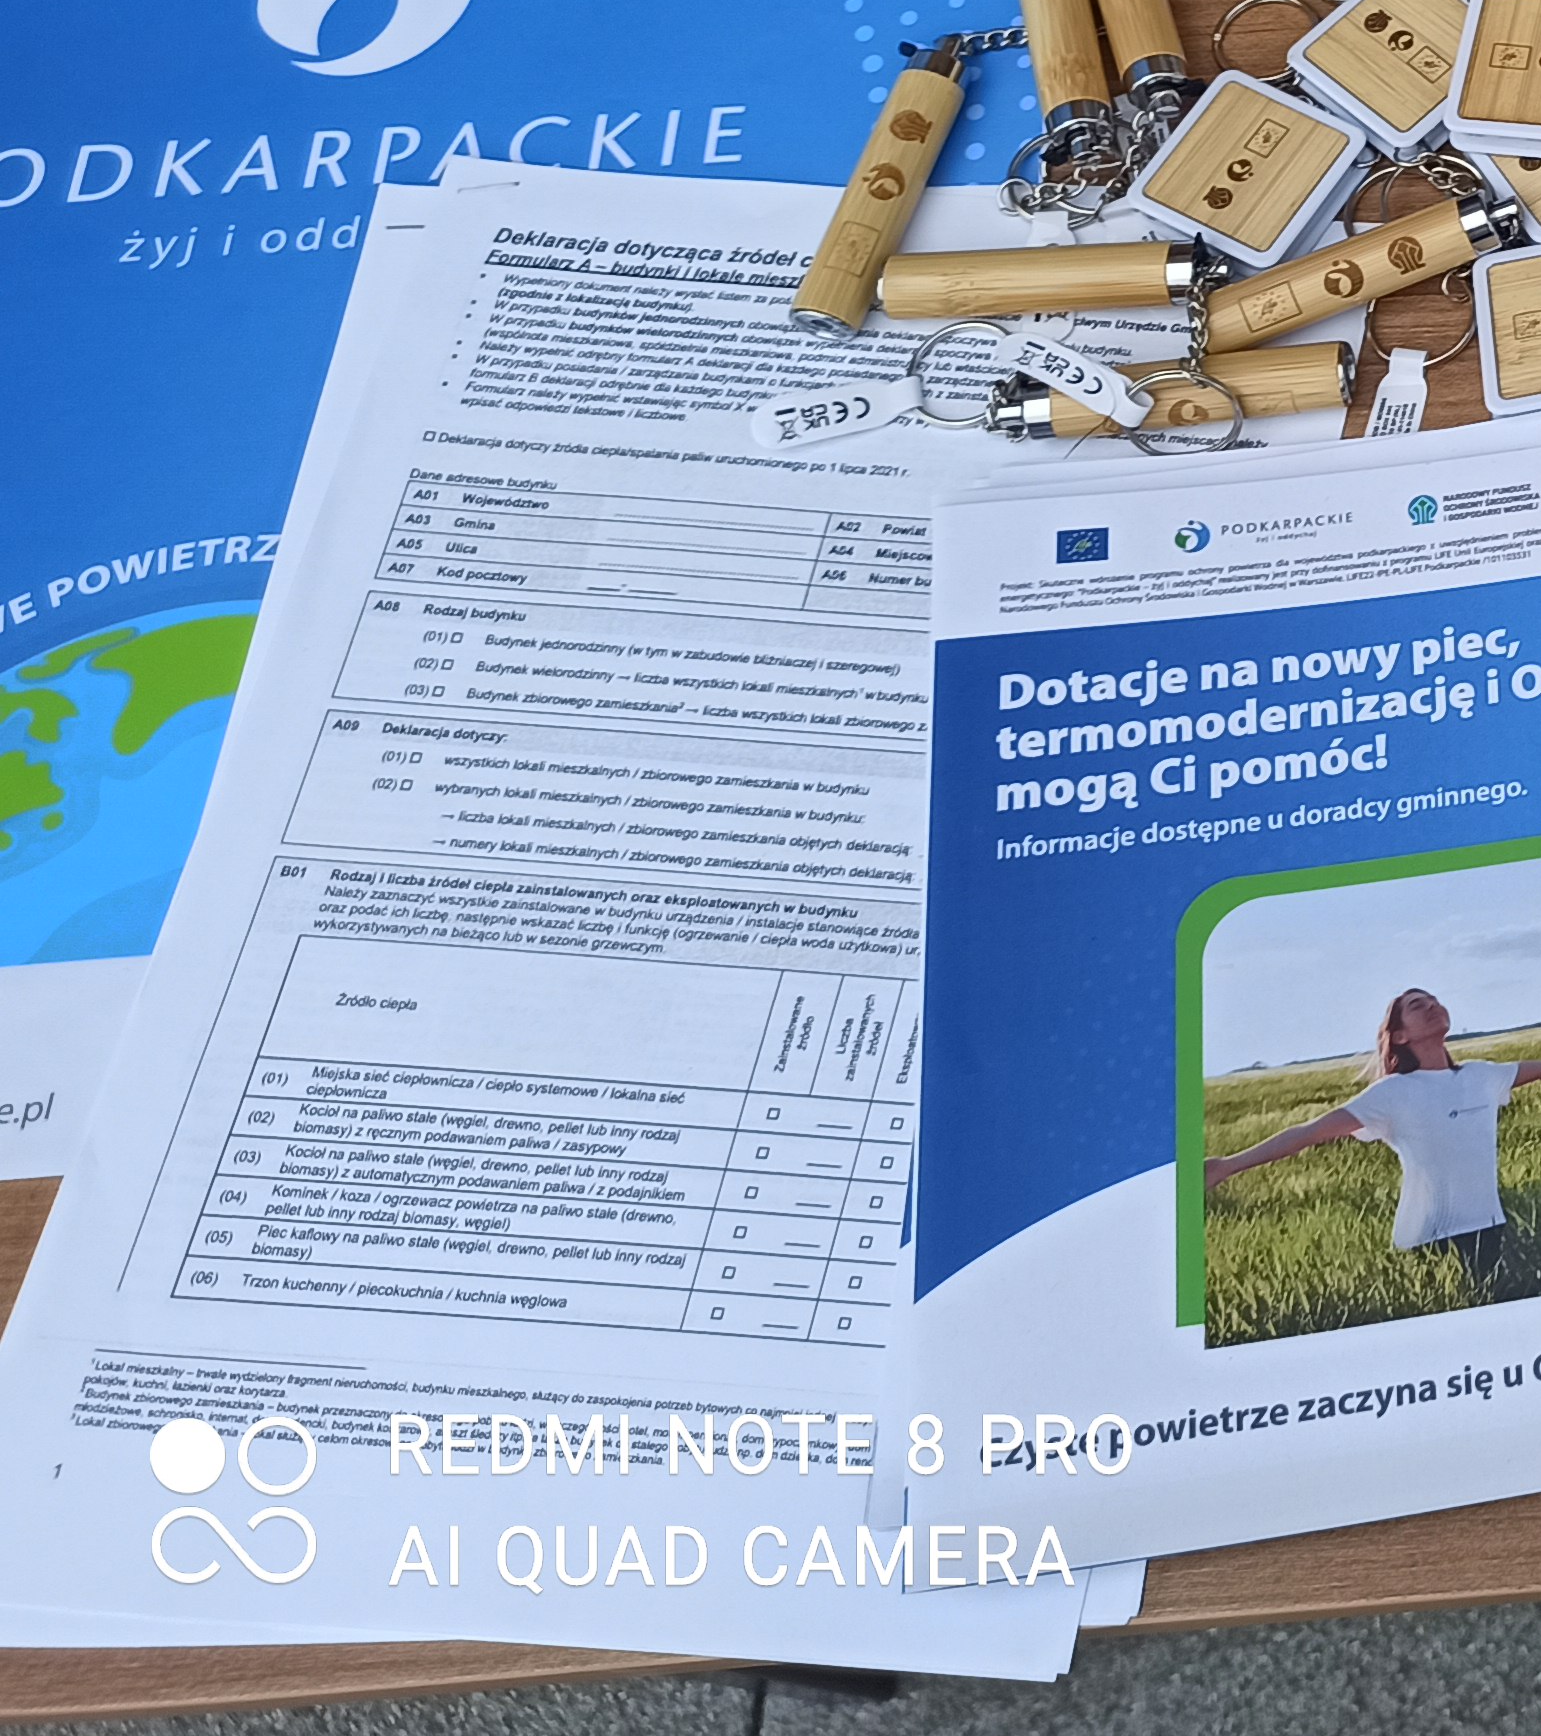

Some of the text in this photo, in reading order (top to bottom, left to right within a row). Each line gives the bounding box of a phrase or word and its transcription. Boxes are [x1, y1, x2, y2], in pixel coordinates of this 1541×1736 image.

[118, 223, 236, 271] żyj i
[492, 227, 797, 266] Deklaracja dotycząca źródeł
[409, 467, 557, 493] Dane adresowe budynku
[412, 489, 549, 509] A01 Województwo
[1220, 511, 1352, 535] PODKARPACKIE
[386, 562, 527, 585] A07 Kod pocztowy
[372, 599, 526, 622] A08 Rodzaj budynku
[998, 626, 1519, 710] Dotacje na nowy piec,
[995, 675, 1474, 759] termomodernizację
[1486, 668, 1498, 704] i
[996, 733, 1387, 812] mogą Ci pomóc!
[997, 781, 1527, 859] Informacje dostępne u doradcy gminnego.
[335, 992, 417, 1012] Źródło ciepła
[204, 1226, 686, 1269] (05) Piec kaflowy na paliwo stałe (węgiel, drewno, pellet lub inny rodzaj
[250, 1241, 312, 1260] biomasy)
[1110, 1402, 1290, 1459] powietrze
[1297, 1379, 1436, 1422] zaczyna
[1447, 1364, 1493, 1400] się
[1503, 1364, 1523, 1387] u
